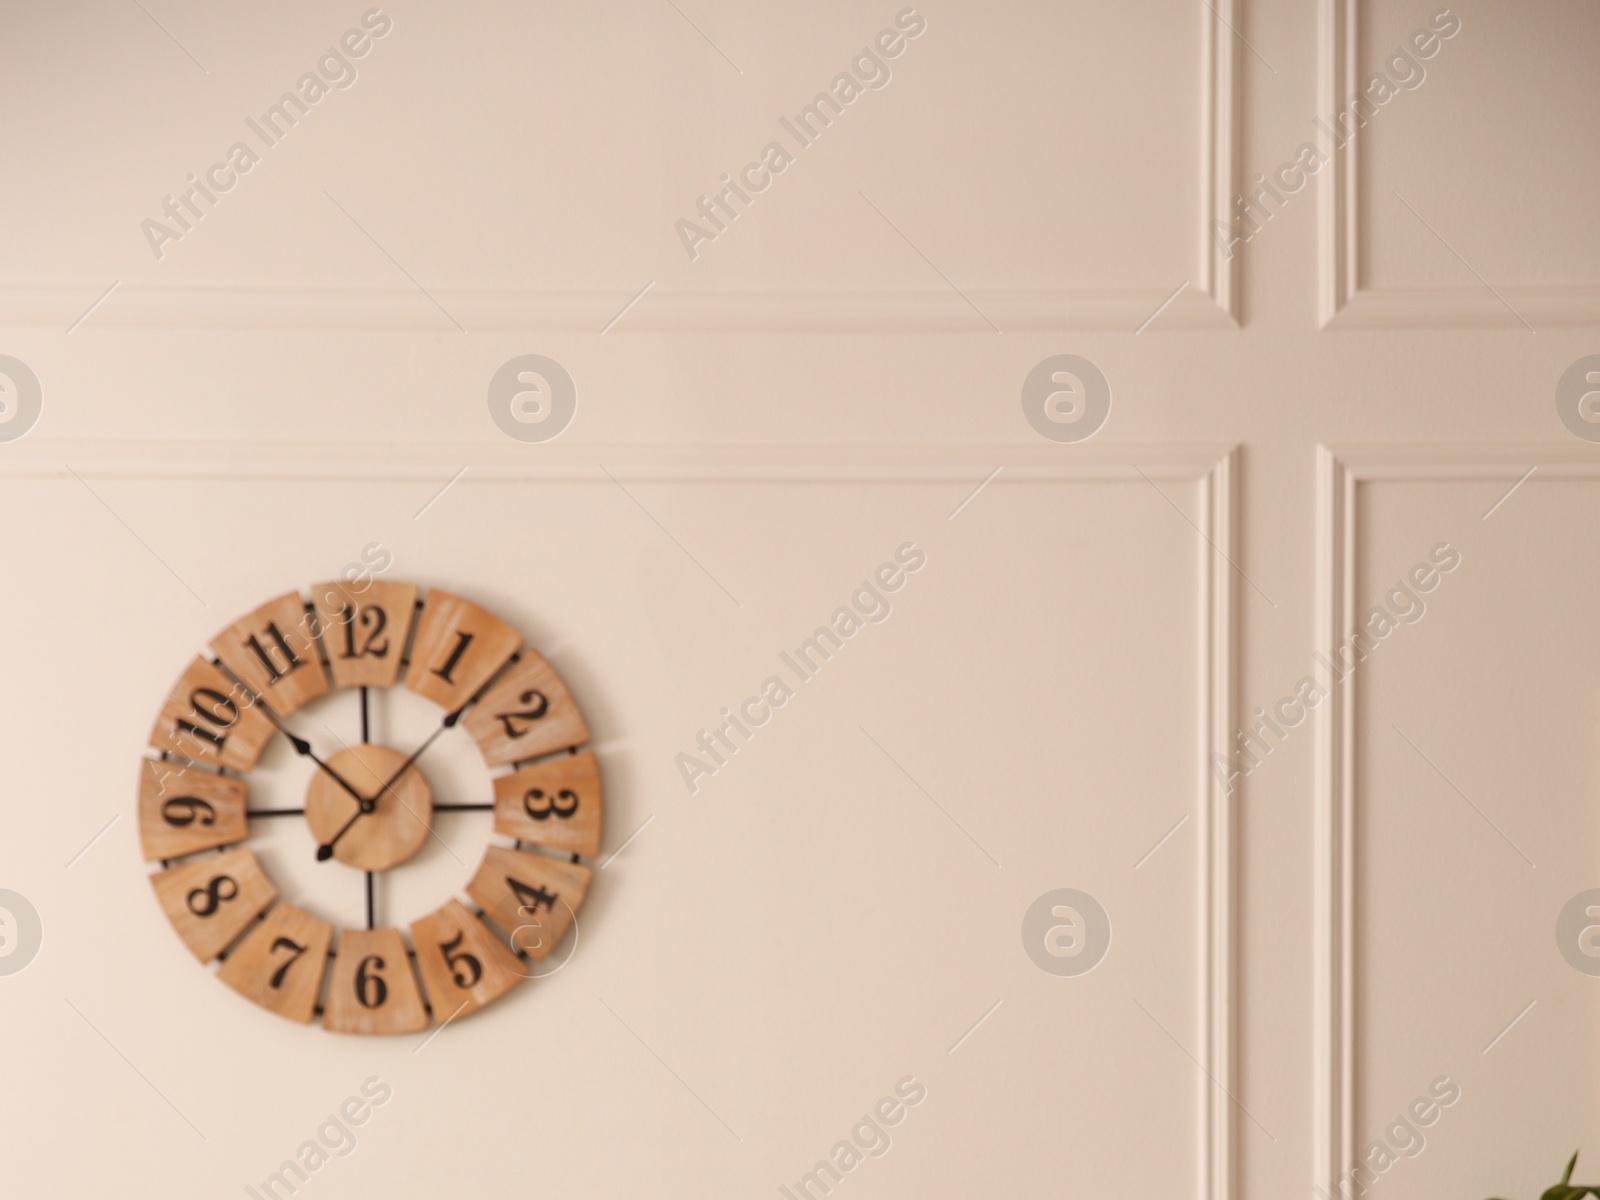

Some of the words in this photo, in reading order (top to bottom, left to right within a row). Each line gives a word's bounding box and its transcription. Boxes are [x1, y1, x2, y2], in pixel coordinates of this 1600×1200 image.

[243, 621, 310, 688] 11
[339, 604, 390, 658] 12
[430, 630, 474, 685] 1
[174, 687, 240, 753] 10
[495, 690, 550, 739] 2
[161, 795, 217, 827] 9
[523, 788, 578, 820] 3
[186, 875, 238, 918] 8
[505, 875, 559, 914] 4
[269, 937, 309, 989] 7
[354, 955, 387, 1009] 6
[439, 930, 483, 989] 5
